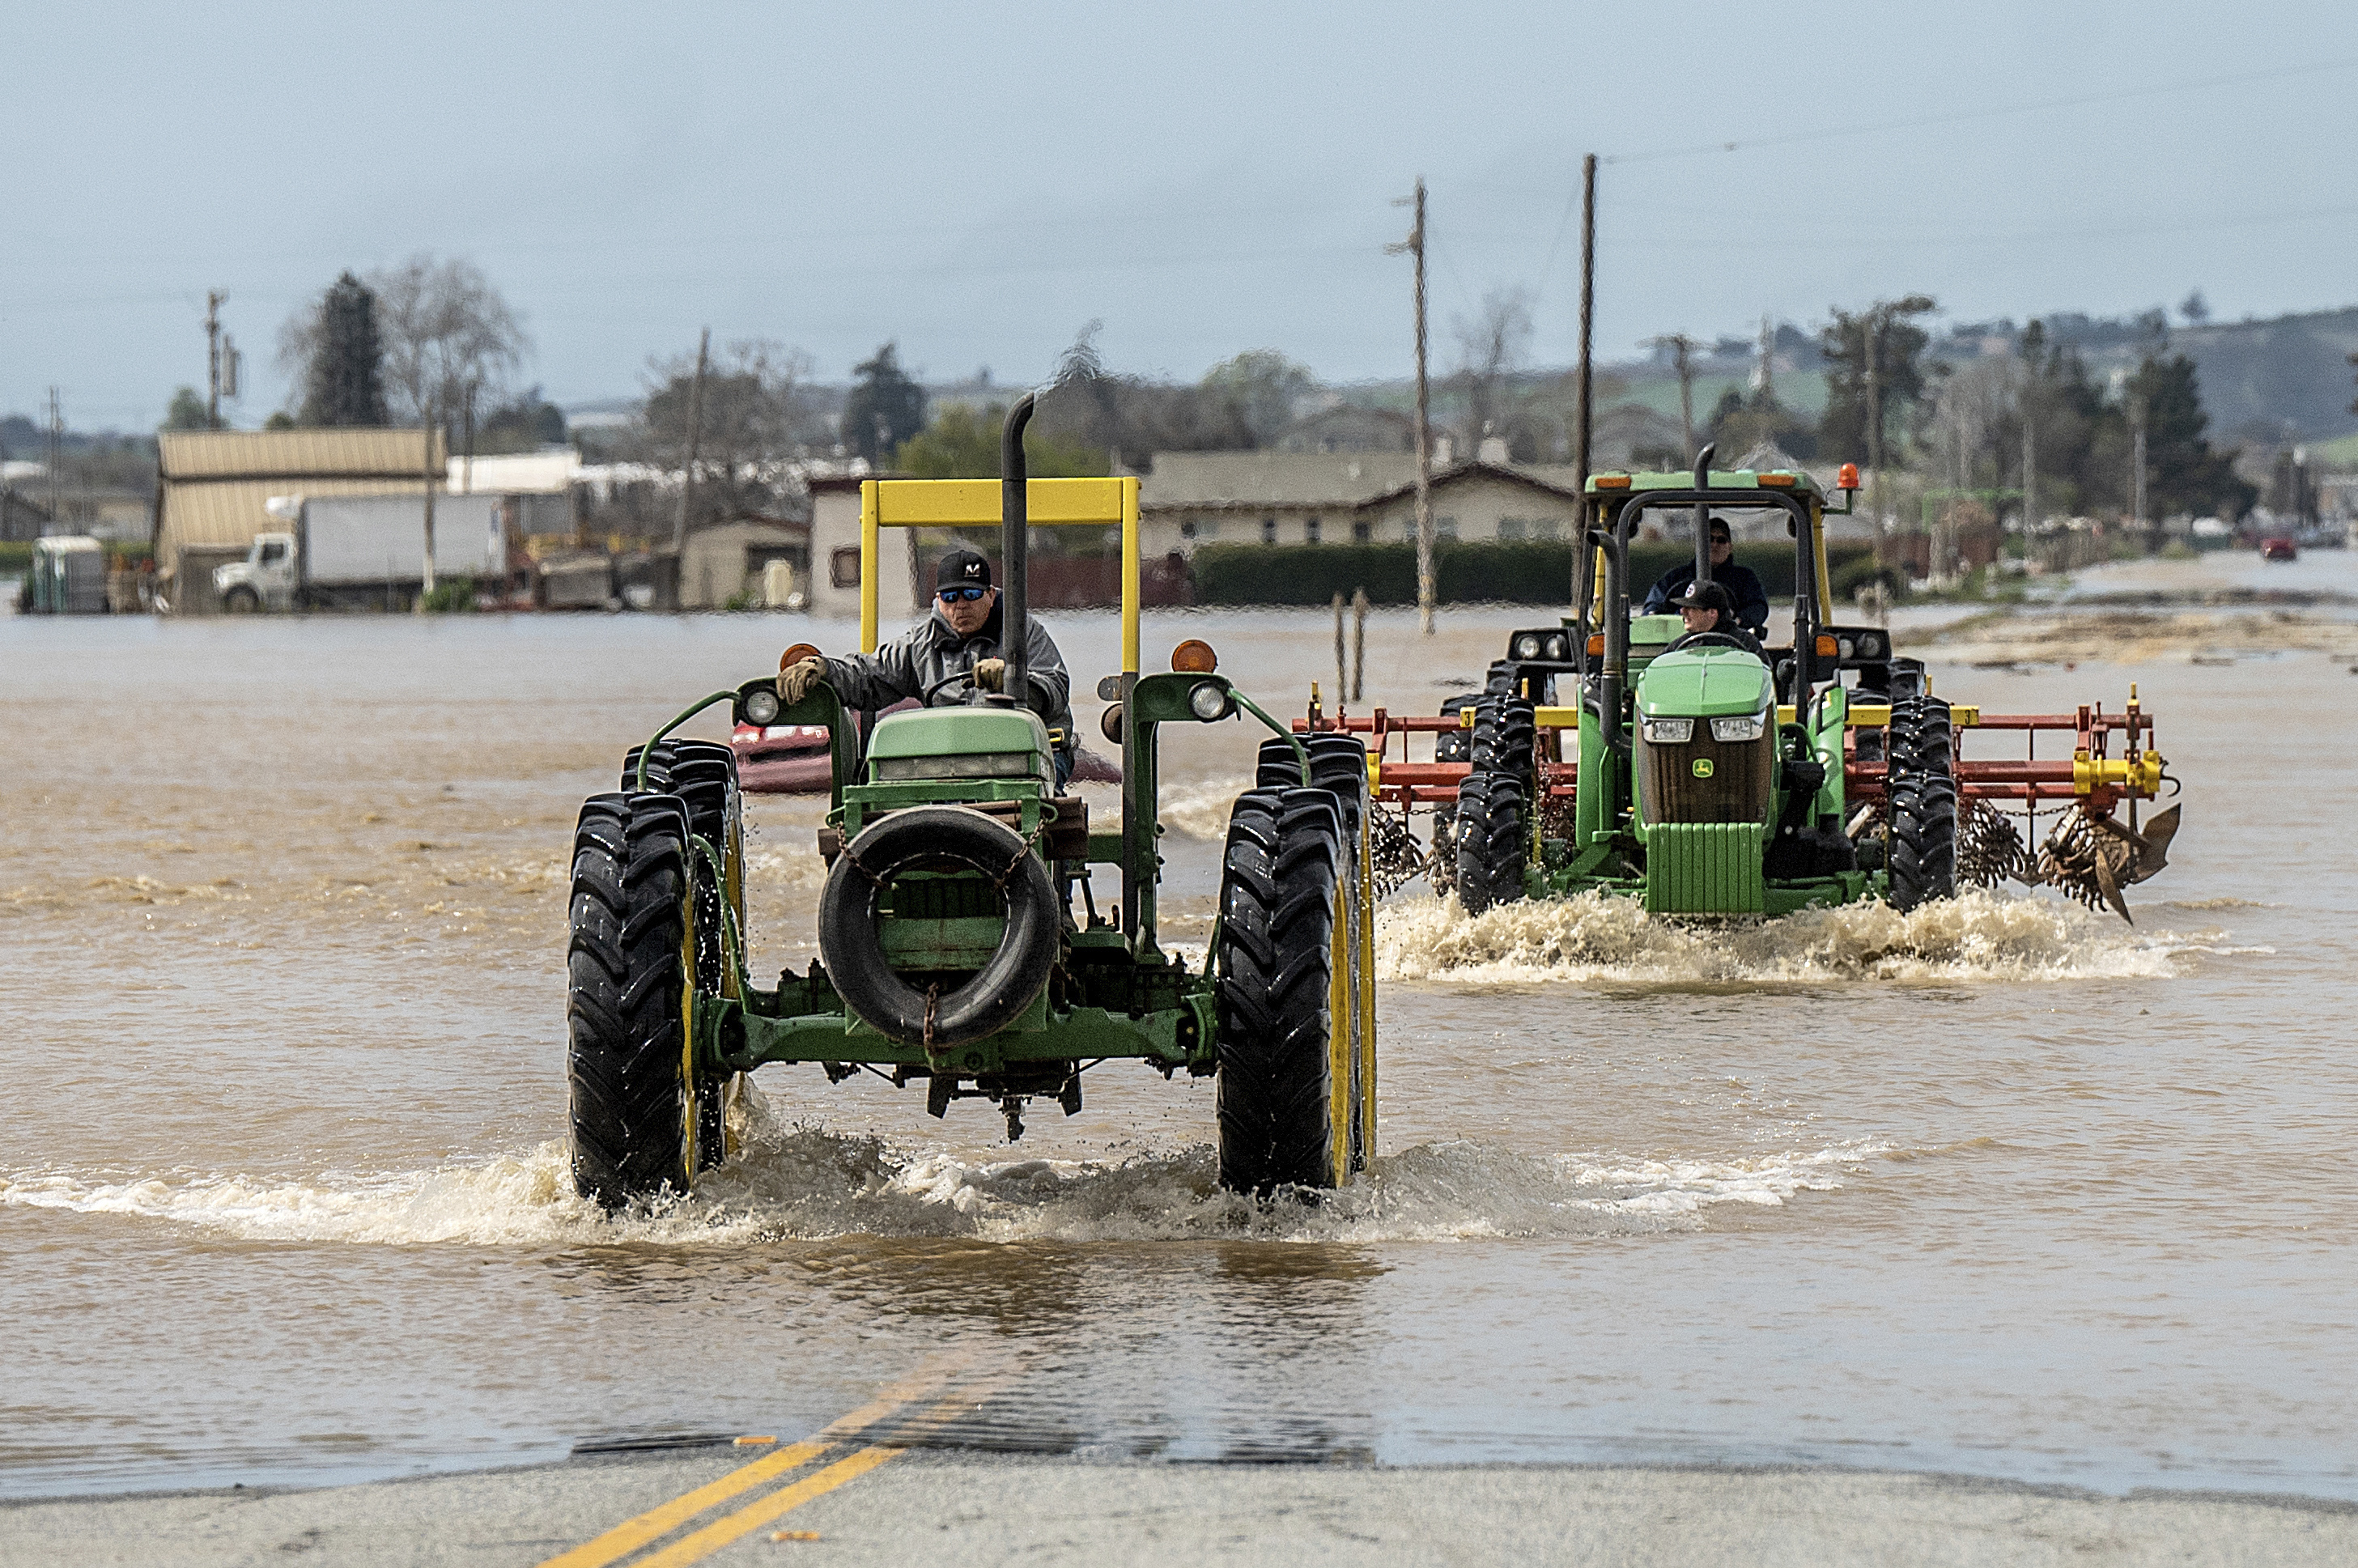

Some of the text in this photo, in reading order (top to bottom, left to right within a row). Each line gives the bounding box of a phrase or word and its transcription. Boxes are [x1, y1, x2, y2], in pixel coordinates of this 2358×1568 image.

[964, 563, 979, 577] M
[1464, 711, 1470, 726] 3
[1965, 709, 1970, 725] 3
